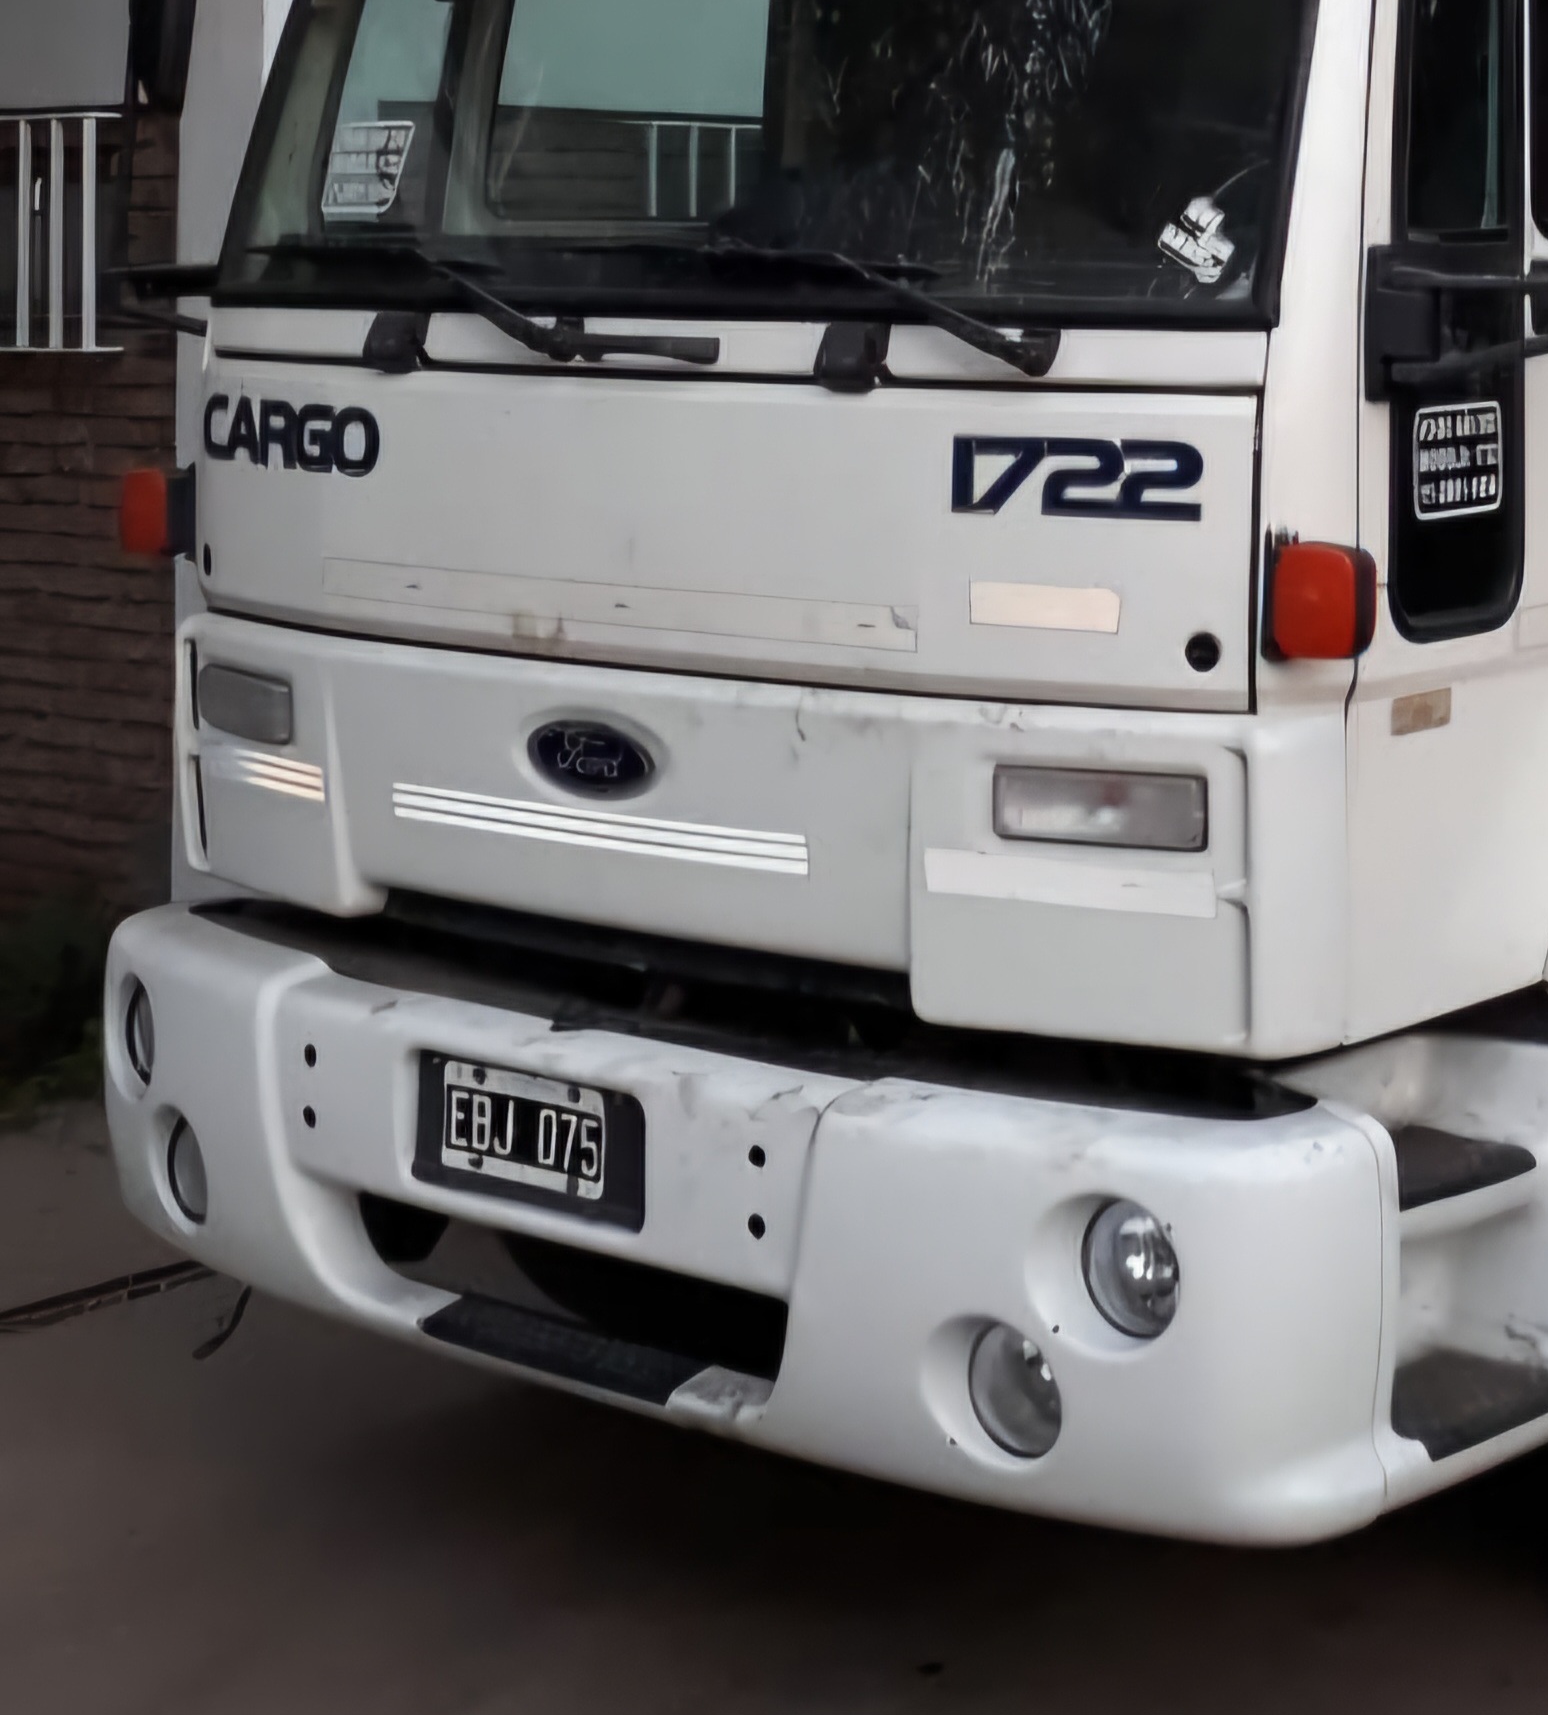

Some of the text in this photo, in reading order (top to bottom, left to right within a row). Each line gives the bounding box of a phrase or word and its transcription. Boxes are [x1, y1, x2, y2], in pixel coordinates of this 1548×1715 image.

[203, 392, 381, 477] CARGO
[951, 435, 1203, 521] 1722
[450, 1090, 599, 1177] EBJ 075
